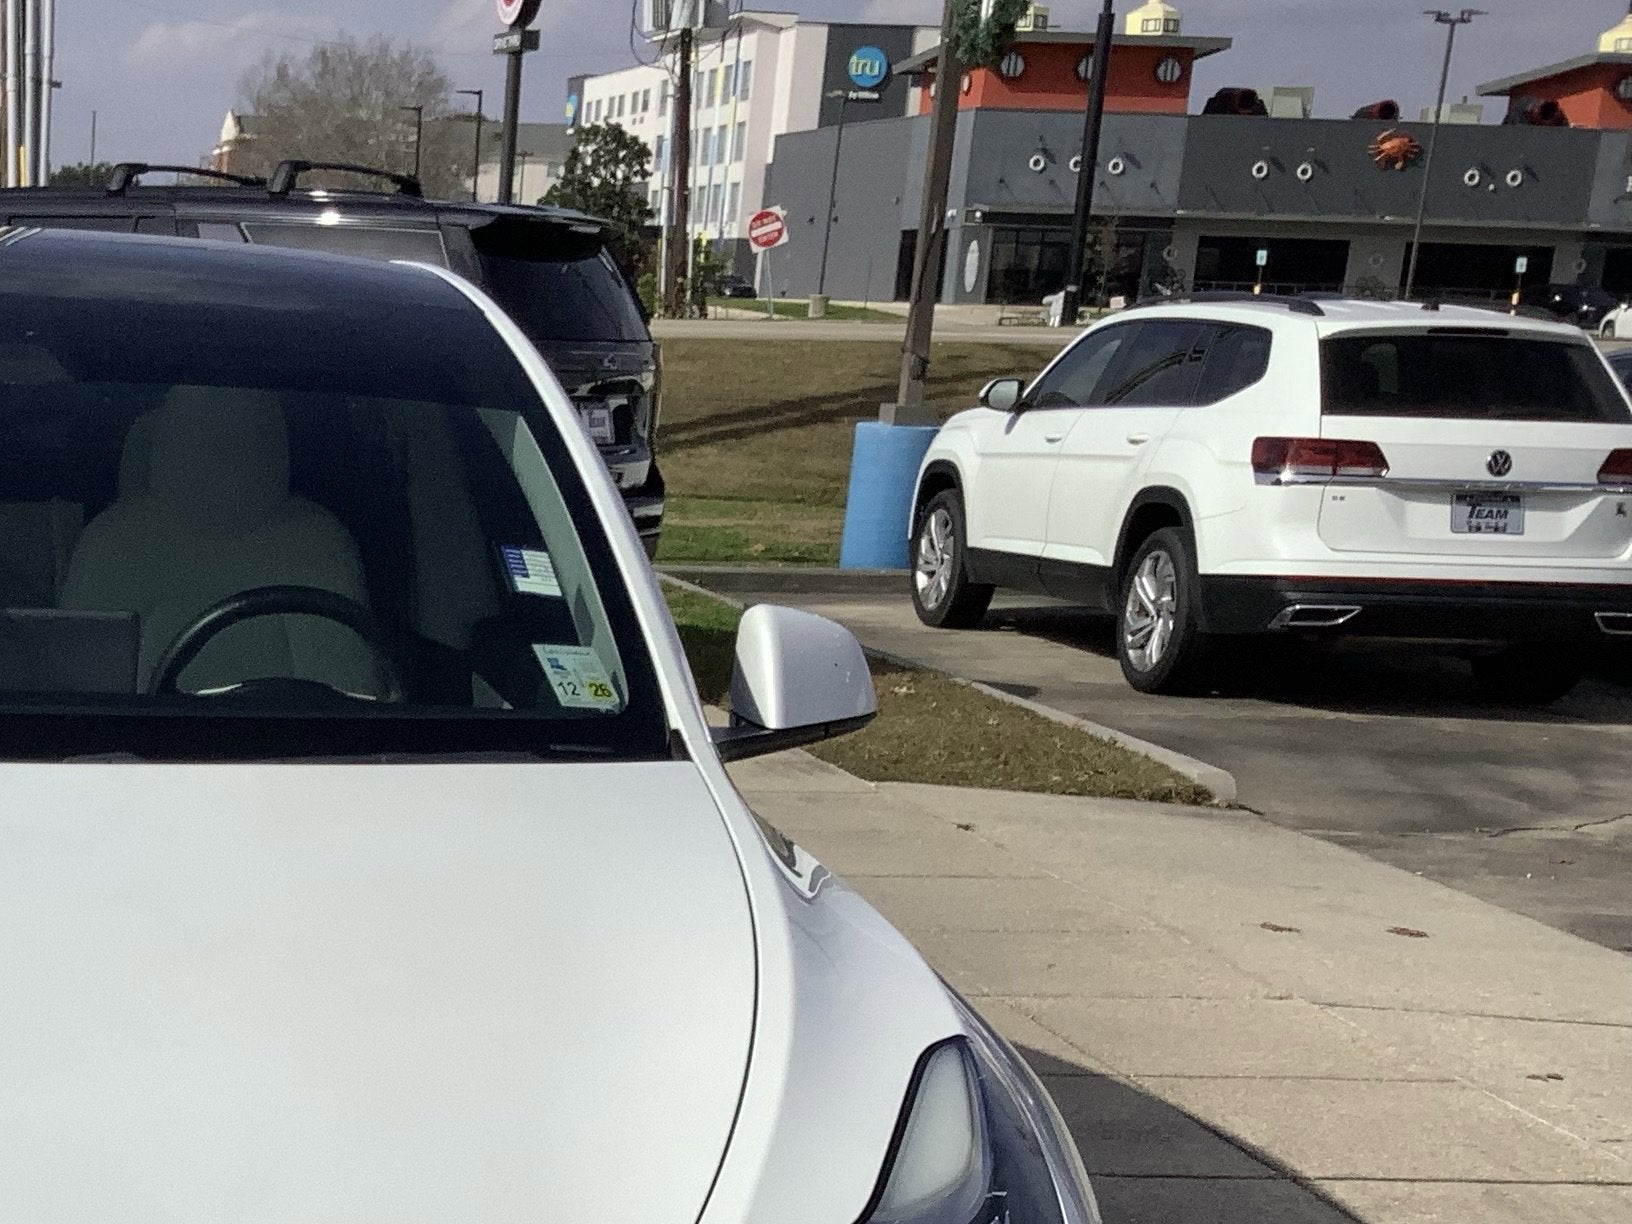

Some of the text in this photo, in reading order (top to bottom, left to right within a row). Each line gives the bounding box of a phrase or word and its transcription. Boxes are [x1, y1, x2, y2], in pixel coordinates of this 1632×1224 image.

[849, 55, 880, 76] tru
[1467, 503, 1509, 520] TEAM
[558, 681, 581, 696] 12
